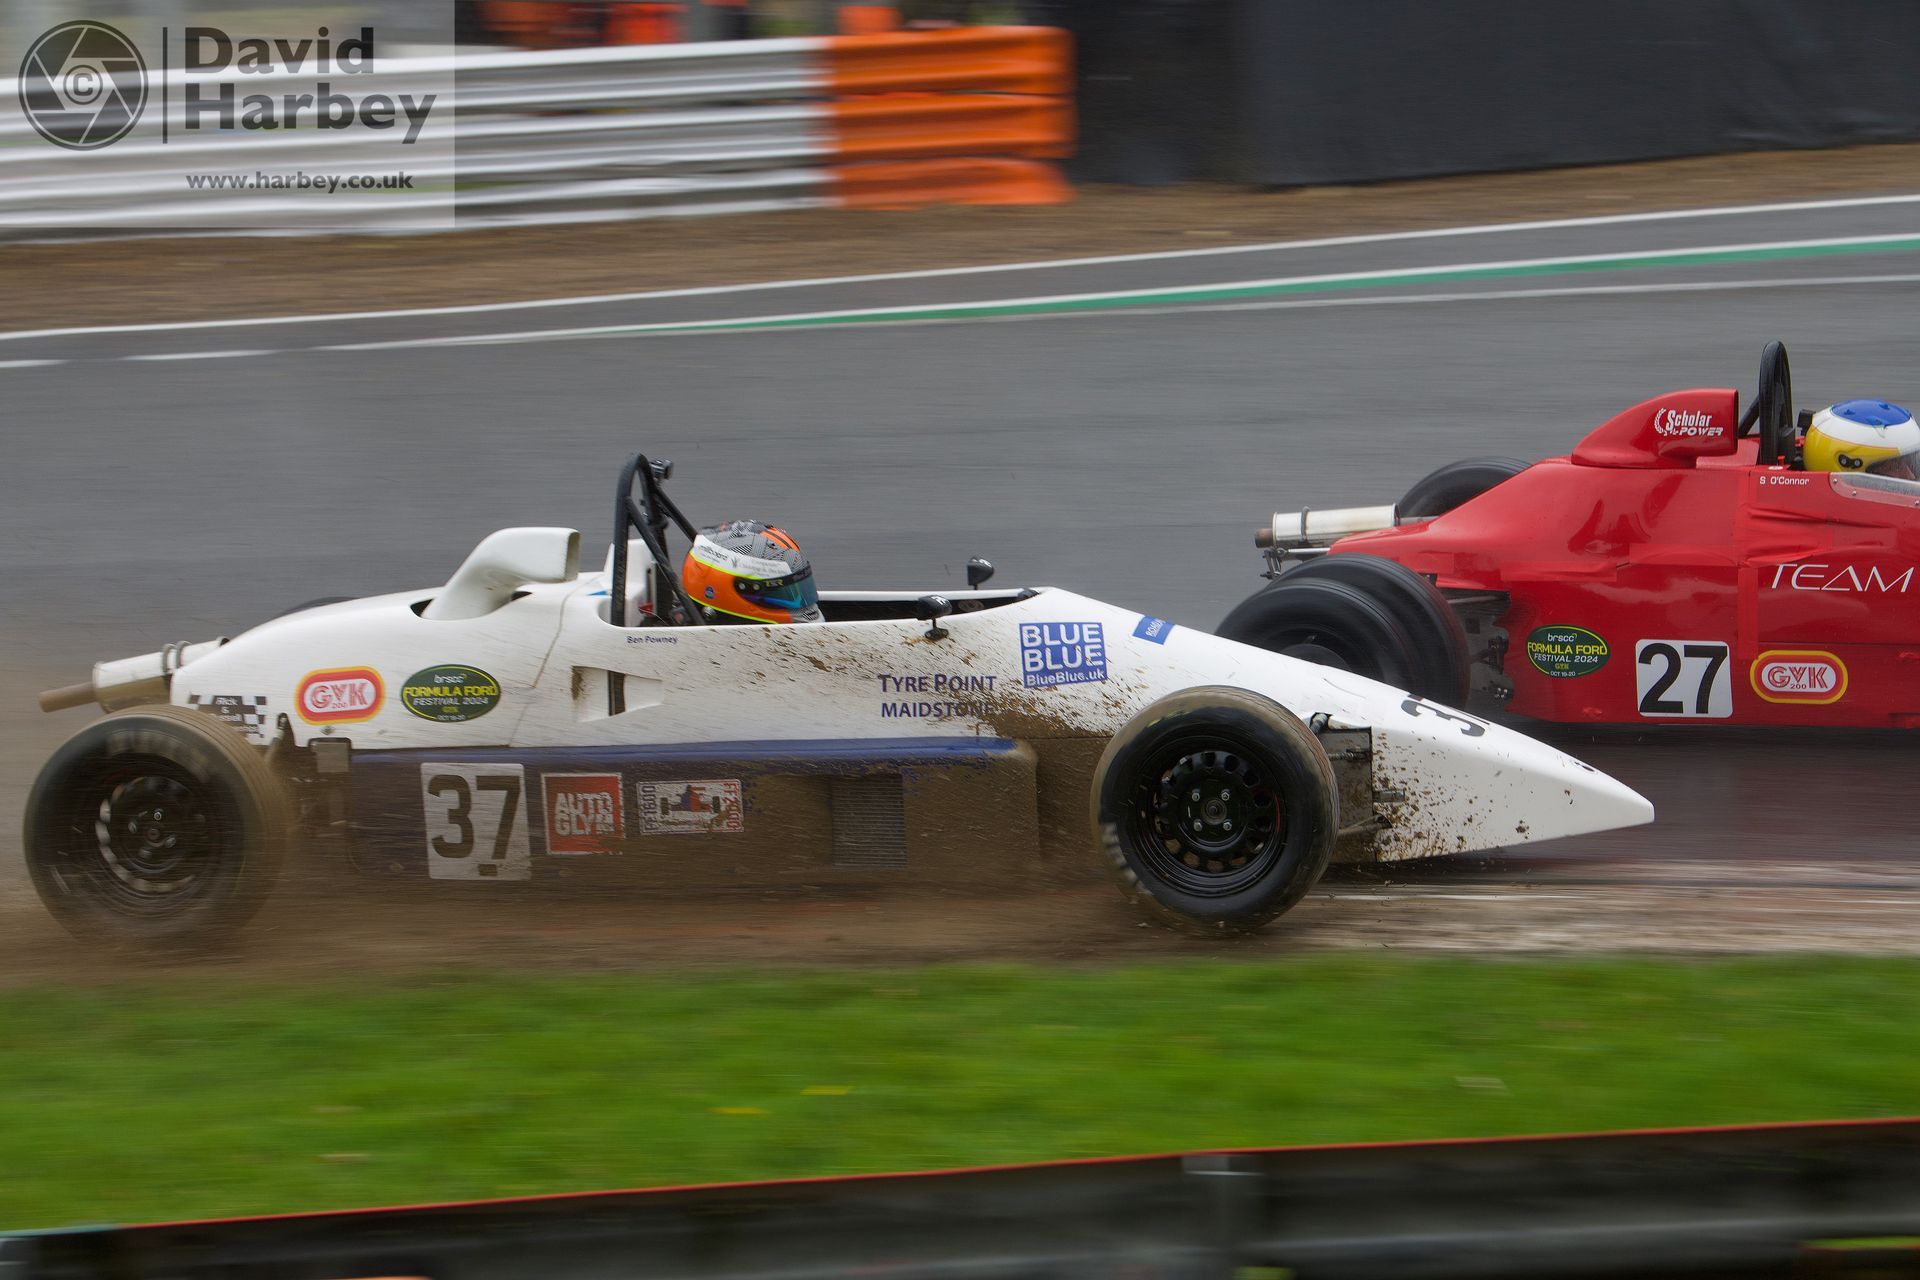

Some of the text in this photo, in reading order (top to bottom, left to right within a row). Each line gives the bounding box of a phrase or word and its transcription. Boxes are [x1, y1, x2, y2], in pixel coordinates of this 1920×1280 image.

[1666, 410, 1712, 431] Scholar
[1679, 427, 1723, 436] POWER
[1759, 476, 1810, 485] S O'Connor
[1771, 563, 1914, 593] TEAM
[626, 635, 643, 644] Ben
[1022, 624, 1100, 648] BLUE
[1547, 633, 1575, 642] brscc
[1024, 644, 1104, 672] BLUE
[1527, 641, 1608, 656] FORMULA FORD
[1533, 653, 1599, 664] FESTIVAL 2024
[877, 673, 997, 693] TYRE POINT
[1026, 669, 1105, 687] BlueBlue.uk
[1637, 643, 1728, 714] 27
[1767, 665, 1829, 689] GYK
[403, 685, 498, 697] FORMULA FORD
[427, 773, 522, 860] 37
